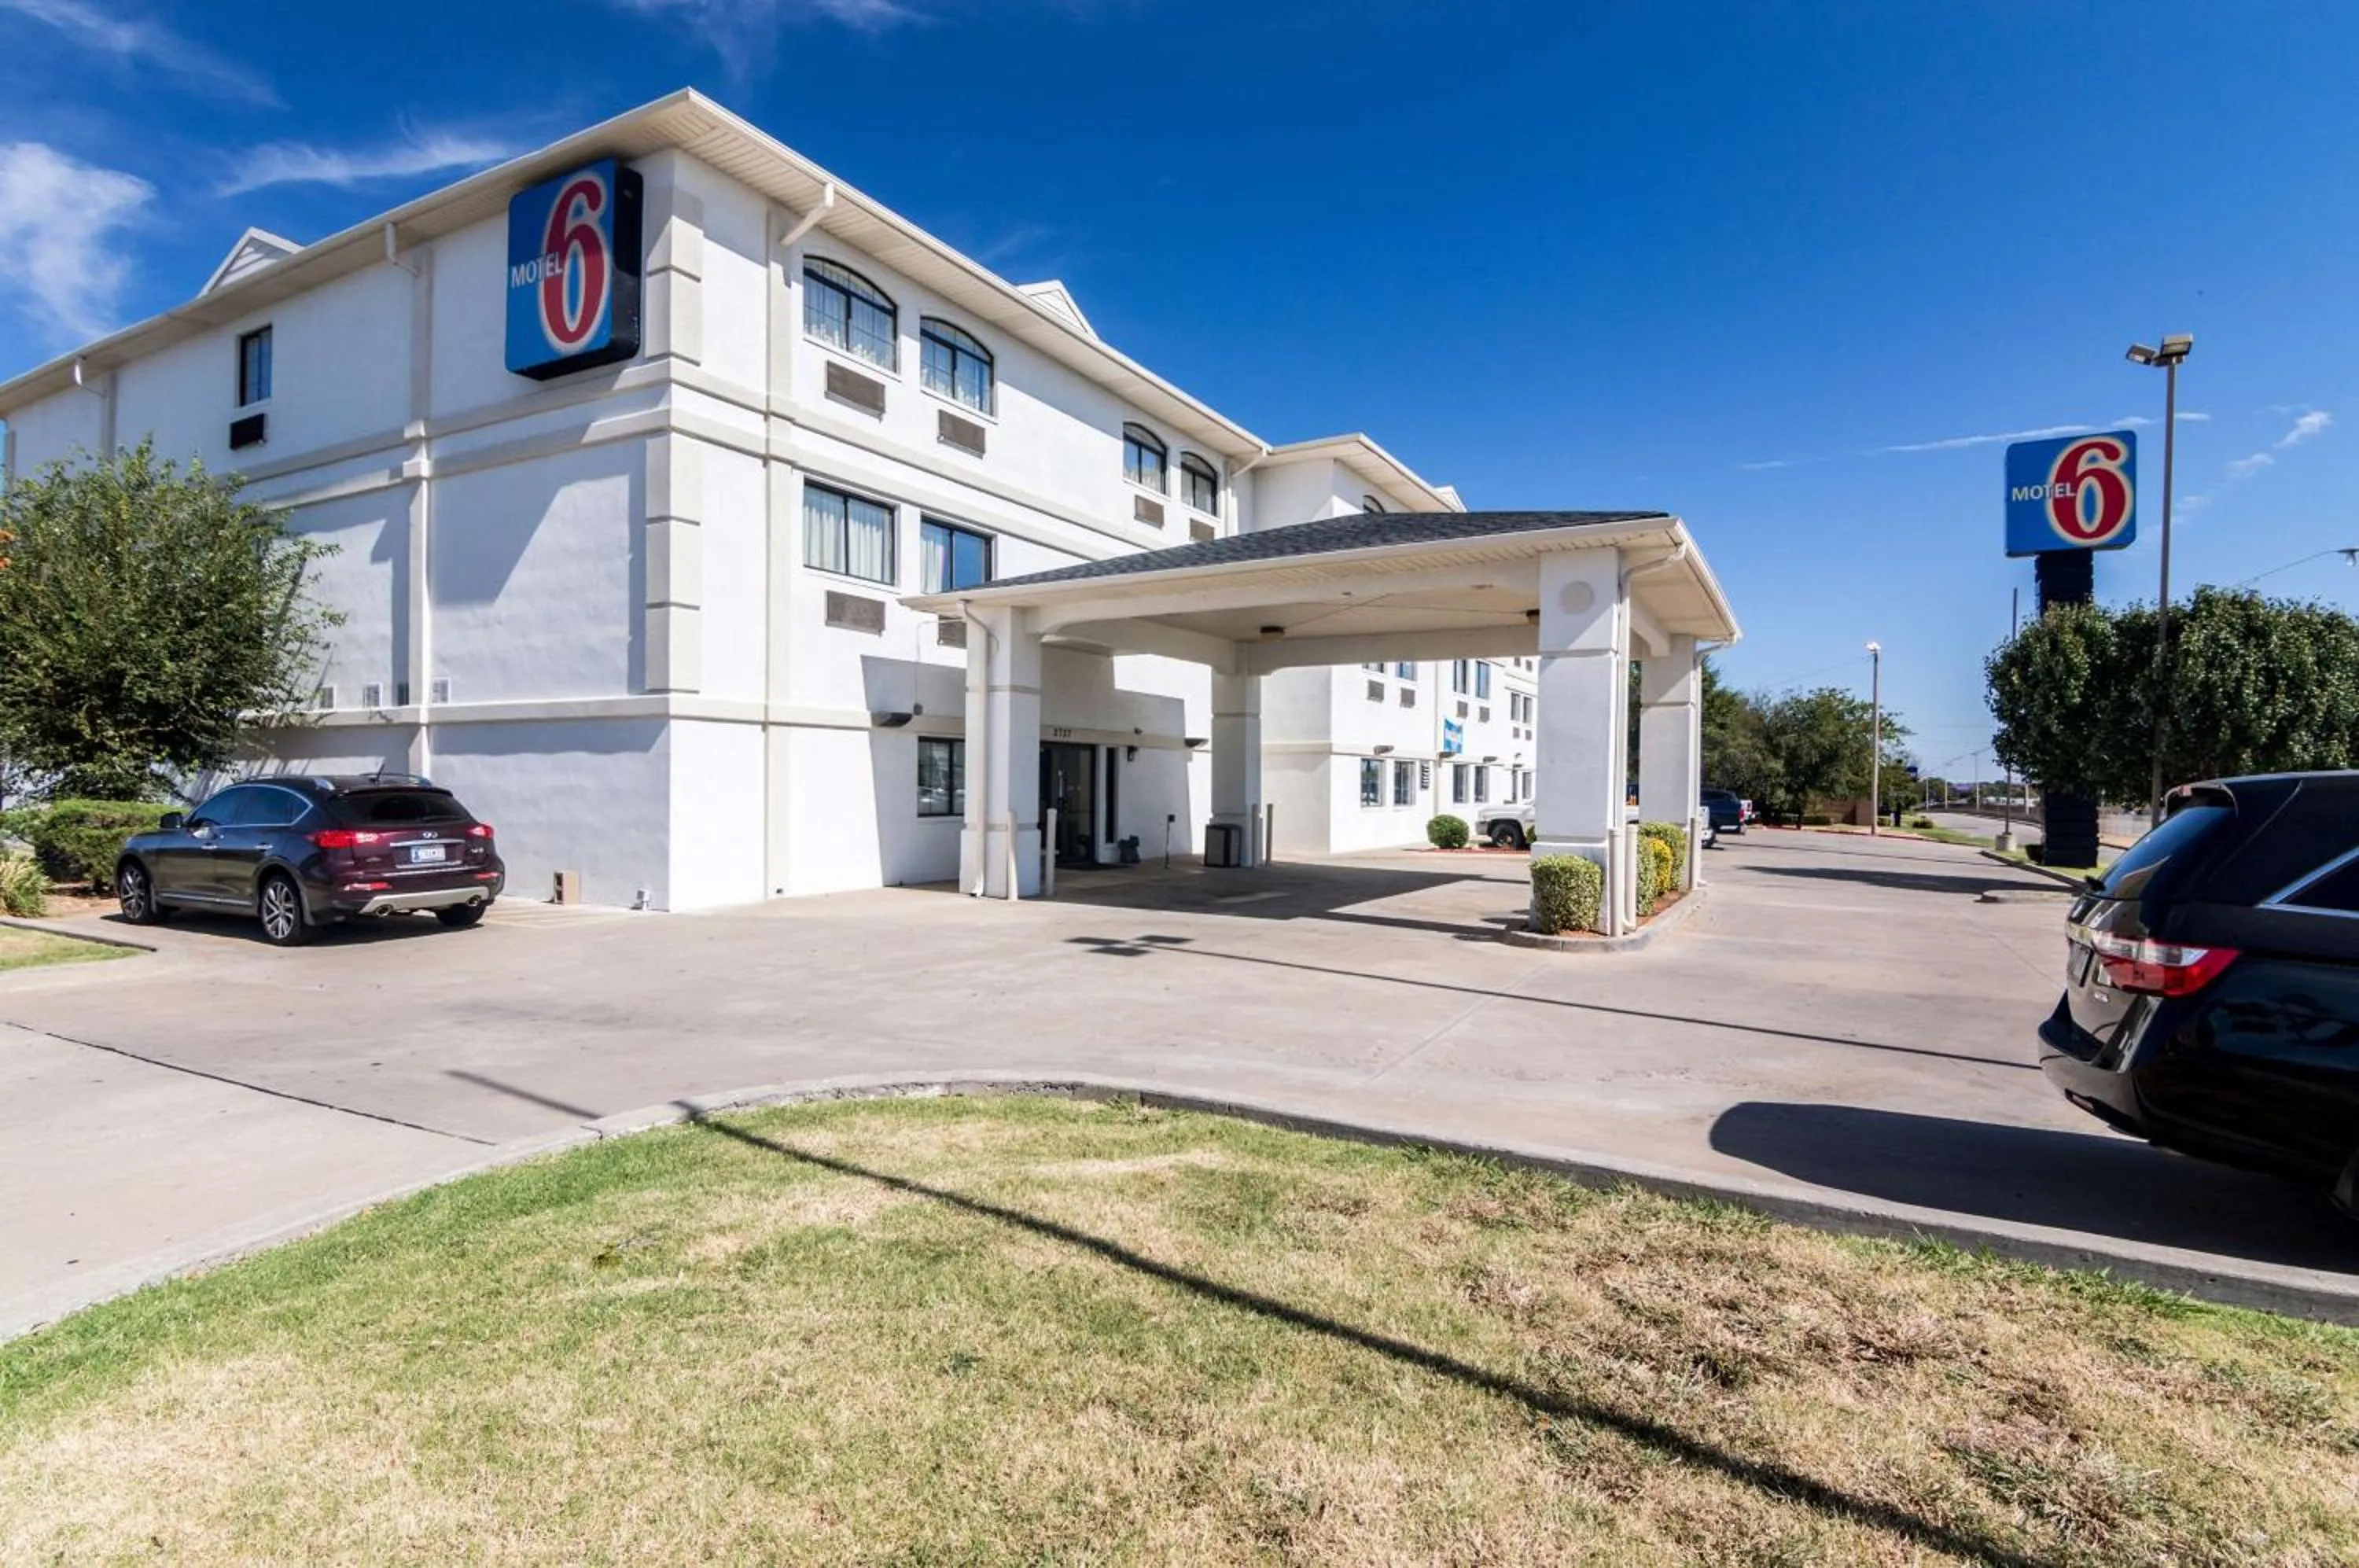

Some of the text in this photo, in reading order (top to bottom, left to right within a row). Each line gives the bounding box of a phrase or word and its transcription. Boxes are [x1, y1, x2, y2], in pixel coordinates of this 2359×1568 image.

[511, 173, 608, 350] MOTEL 6
[2011, 437, 2132, 545] MOTEL 6
